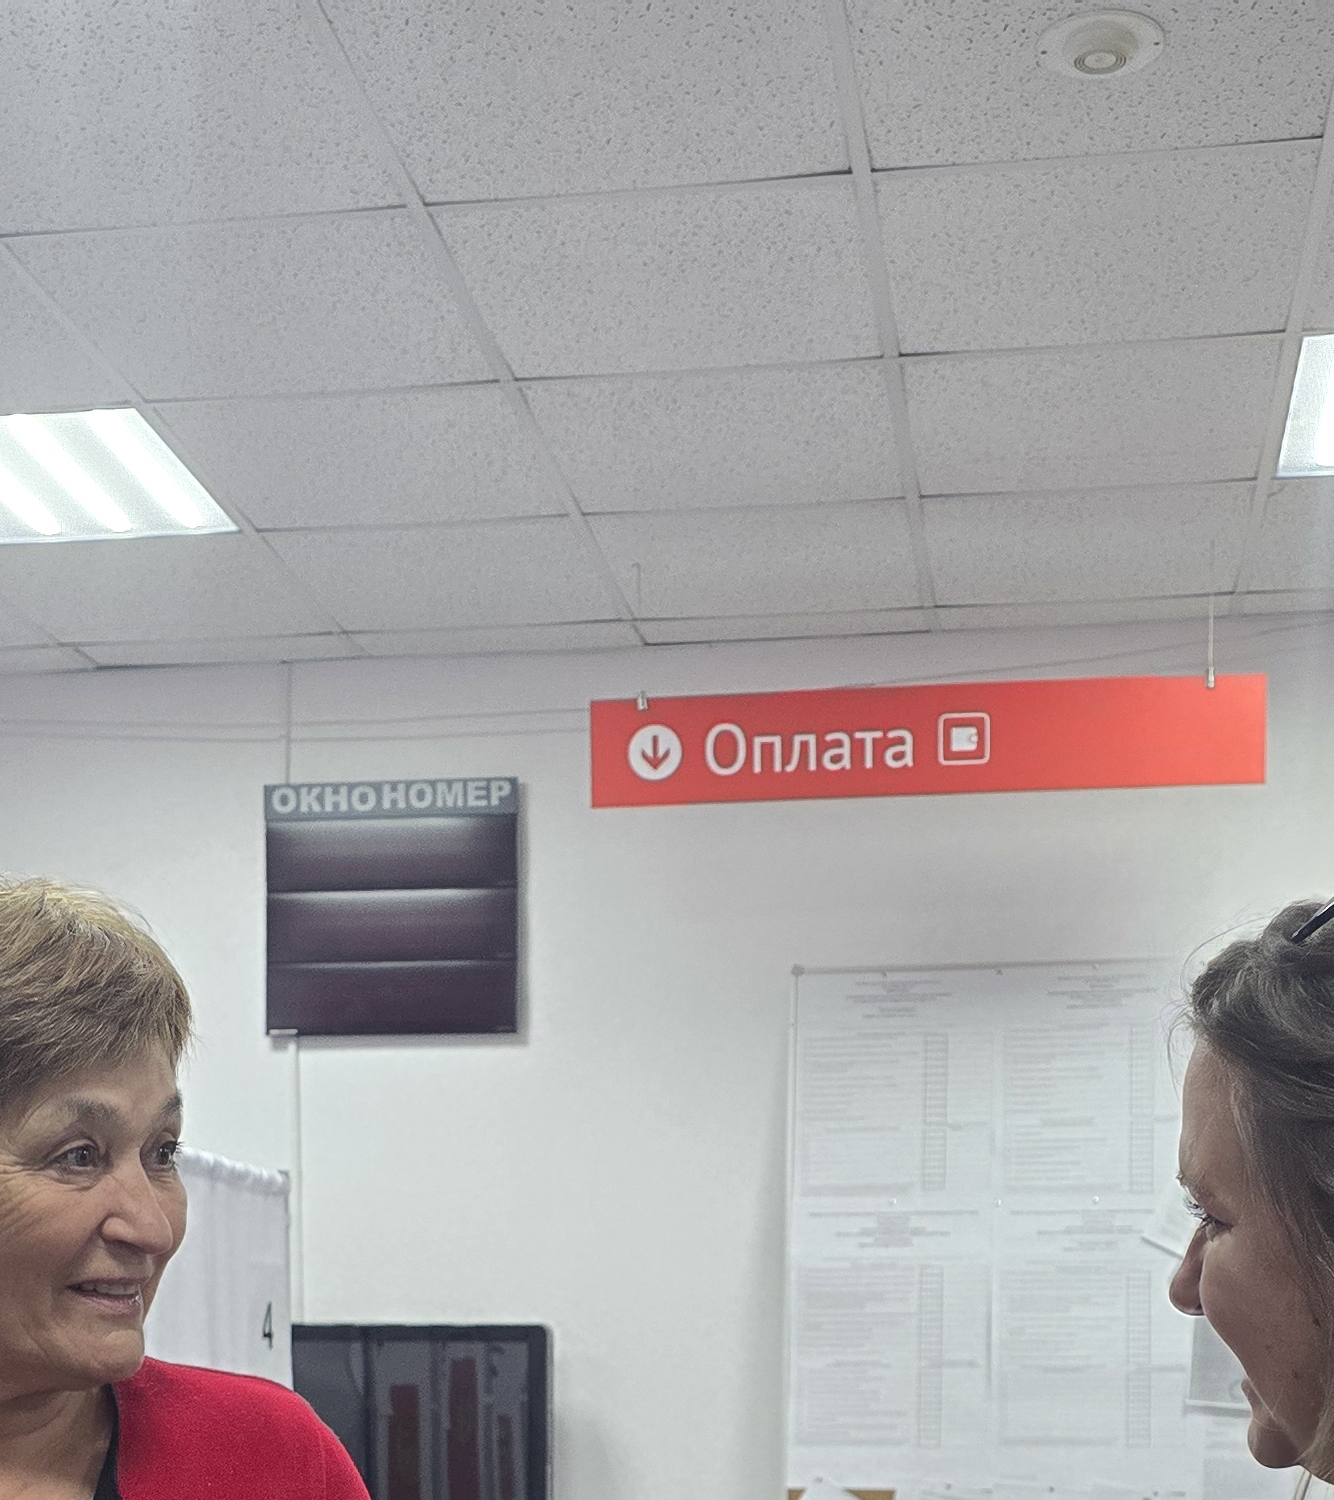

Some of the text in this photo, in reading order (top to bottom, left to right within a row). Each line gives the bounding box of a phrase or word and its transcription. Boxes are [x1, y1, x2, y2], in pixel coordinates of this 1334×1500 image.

[703, 721, 916, 778] Оплата
[271, 780, 512, 814] ОКНО НОМЕР
[262, 1301, 274, 1350] 4
